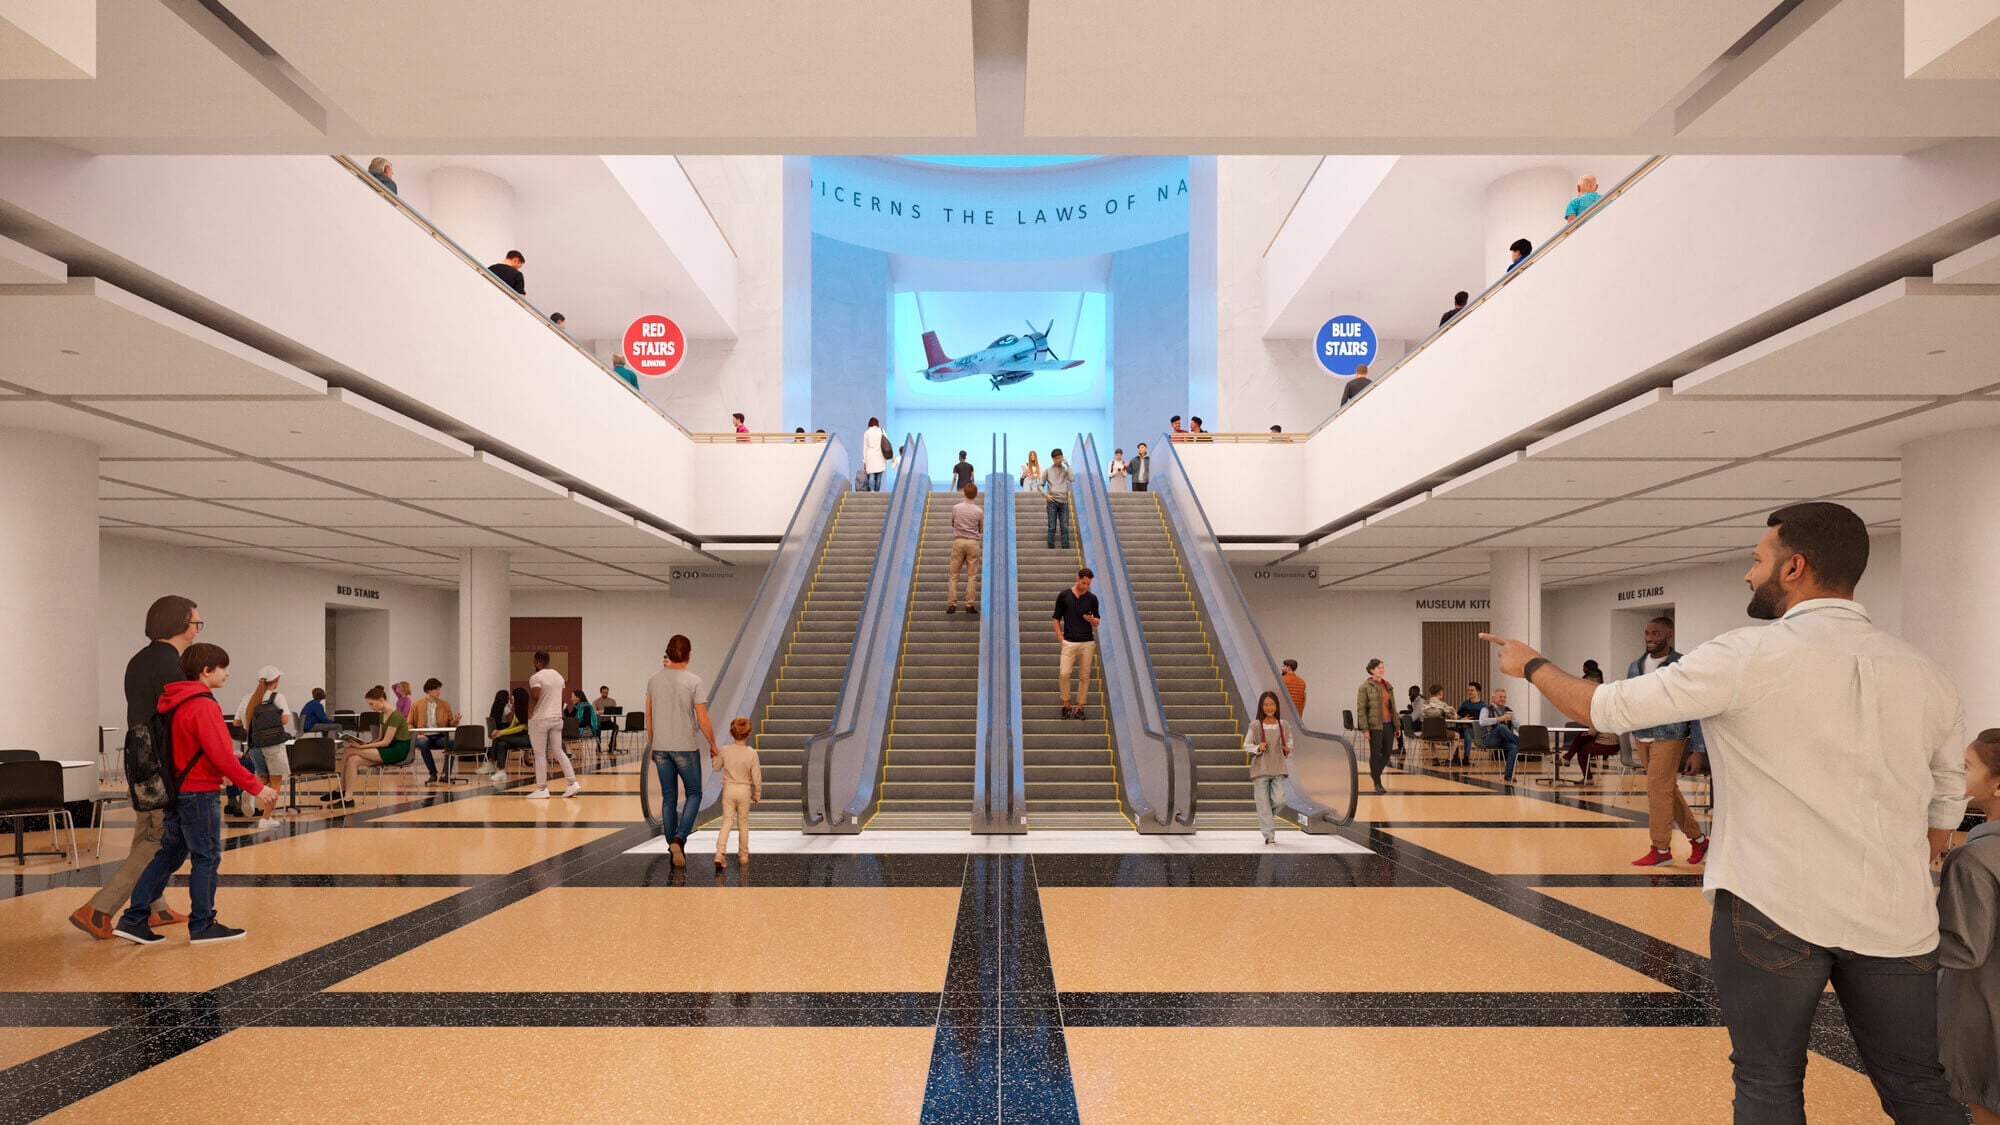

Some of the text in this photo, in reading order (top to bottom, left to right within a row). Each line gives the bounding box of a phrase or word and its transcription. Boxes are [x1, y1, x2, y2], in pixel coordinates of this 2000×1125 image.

[943, 208, 994, 224] THE
[1018, 204, 1087, 224] LAWS
[1105, 195, 1136, 214] OF
[642, 322, 666, 337] RED
[1332, 322, 1361, 337] BLUE
[632, 341, 675, 356] STAIRS
[1325, 341, 1368, 356] STAIRS
[354, 587, 380, 600] STAIRS
[1617, 586, 1664, 601] BLUE STAIRS
[1416, 599, 1466, 609] MUSEUM
